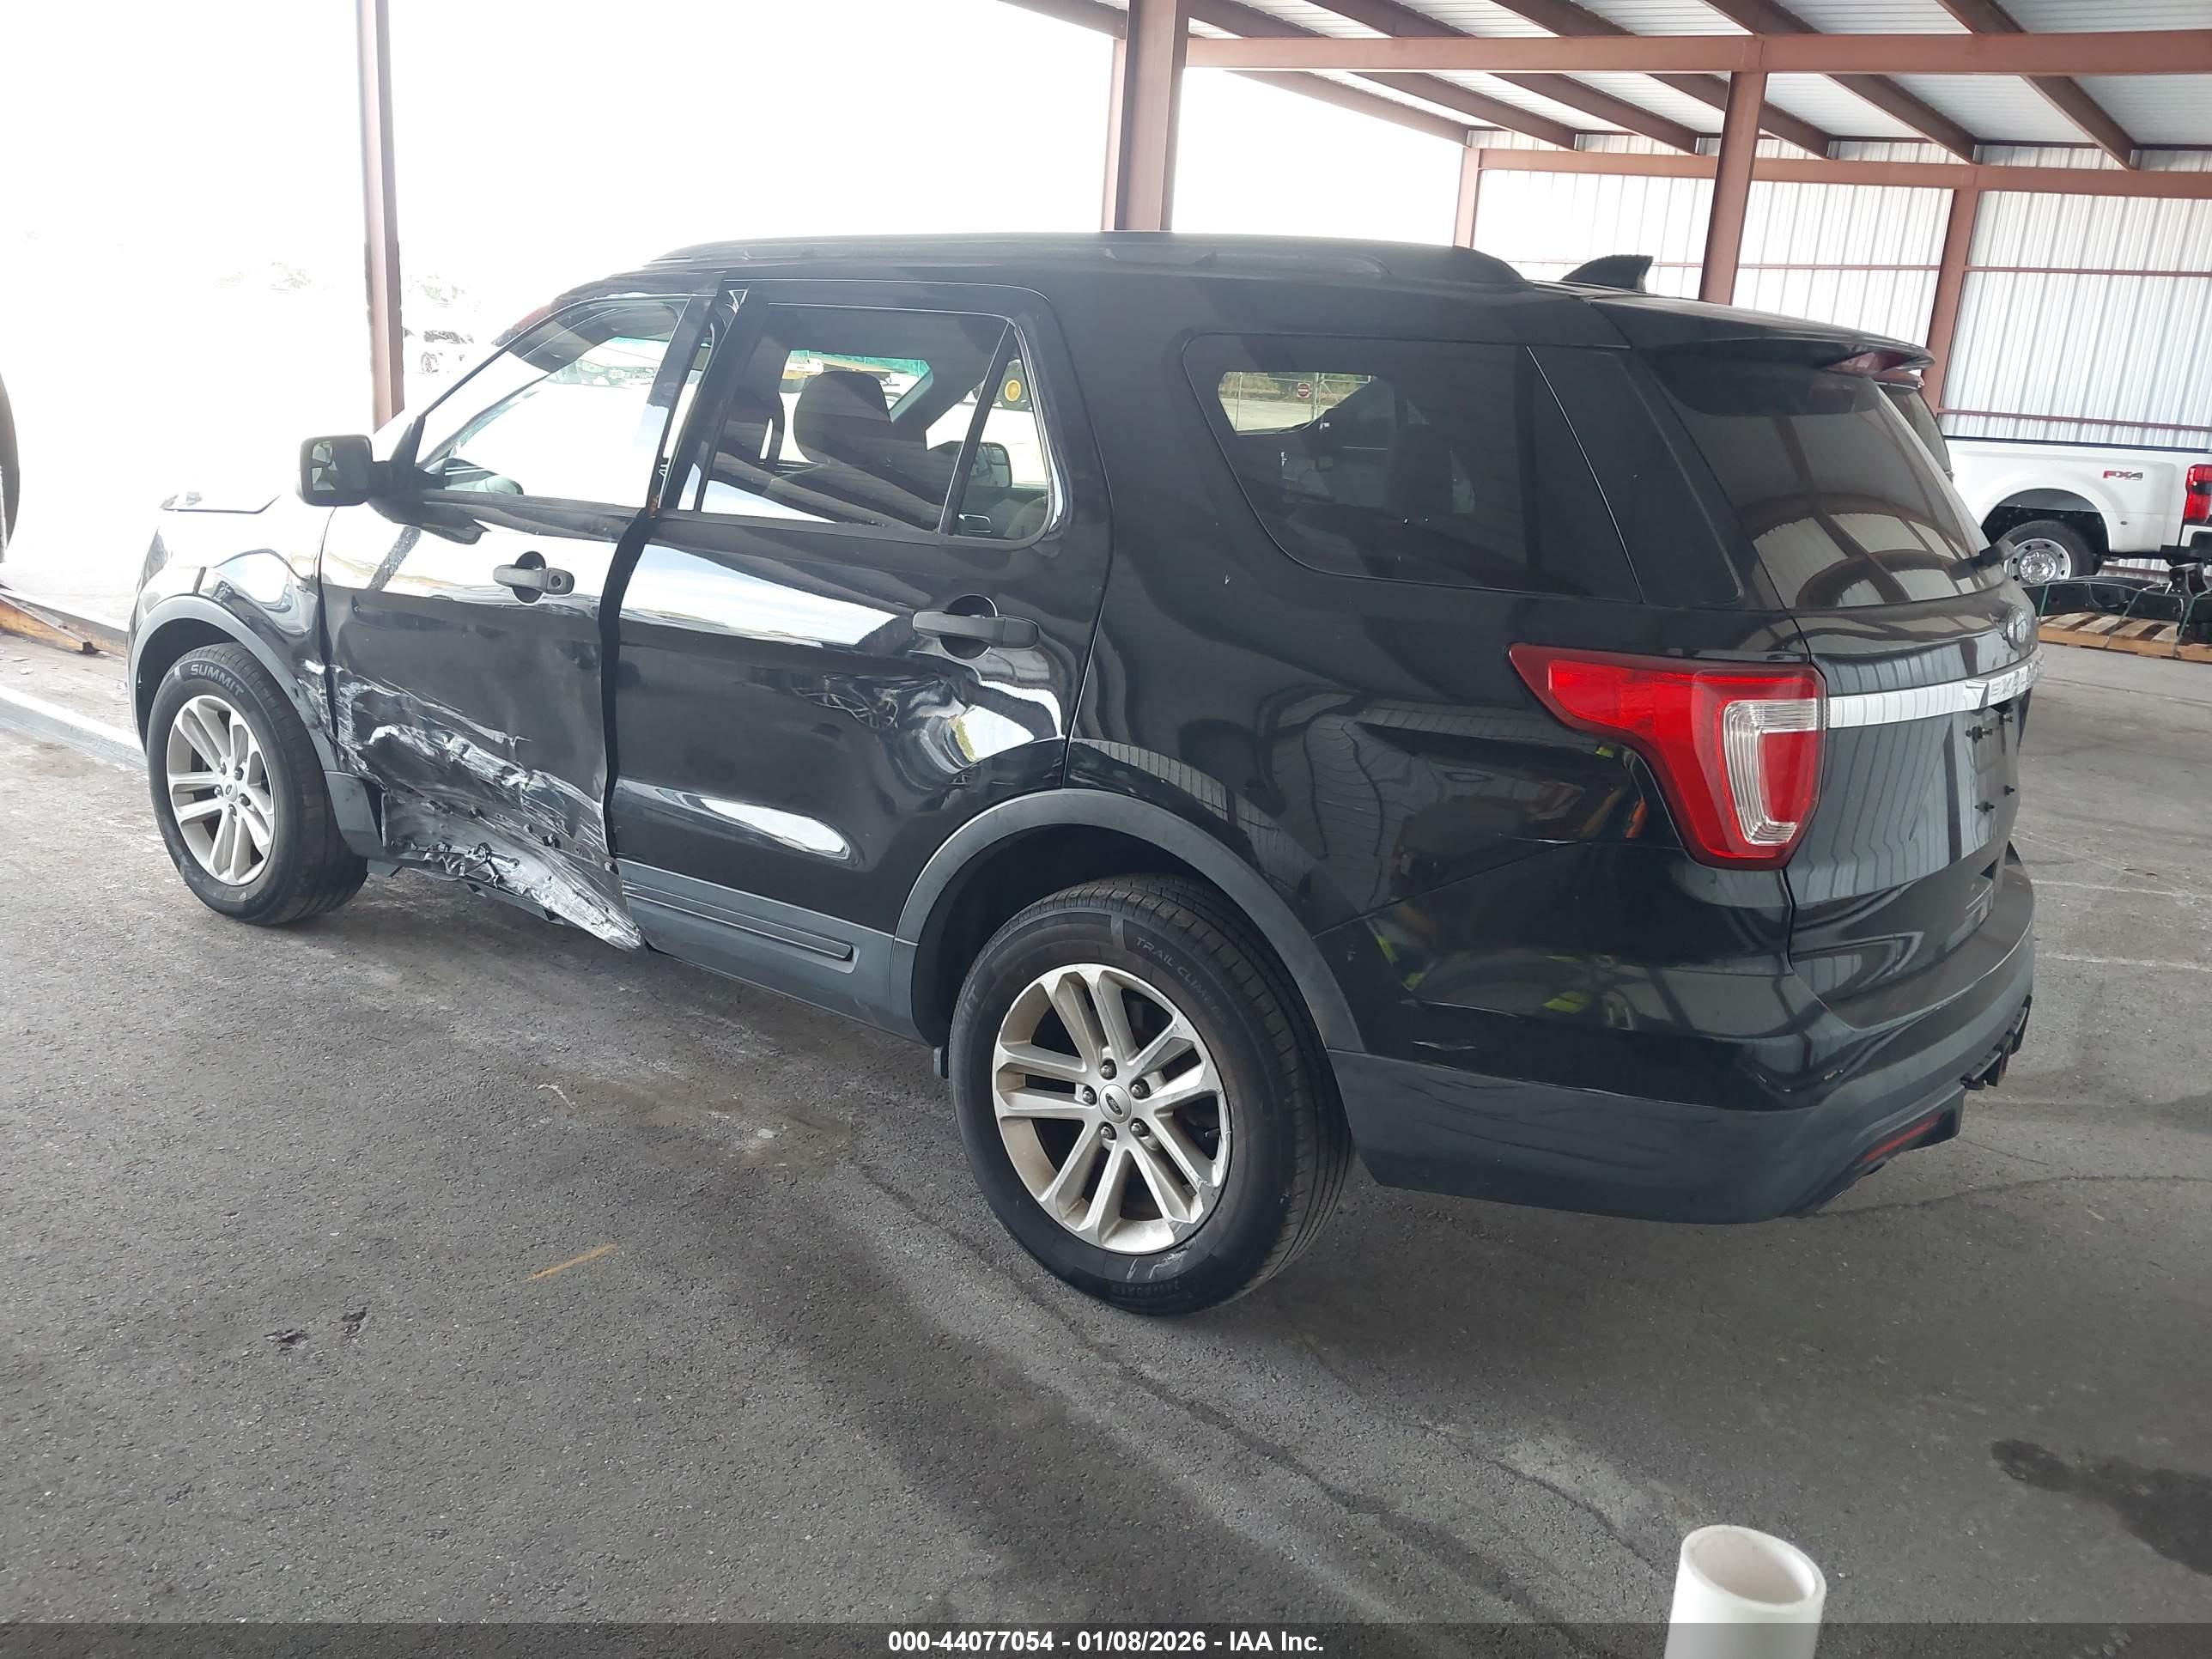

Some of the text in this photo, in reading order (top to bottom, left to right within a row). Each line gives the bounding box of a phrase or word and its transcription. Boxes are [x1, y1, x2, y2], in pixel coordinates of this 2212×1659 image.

[2103, 470, 2143, 480] FX4
[191, 664, 244, 696] SUMMIT
[1136, 937, 1173, 967] TRAIL
